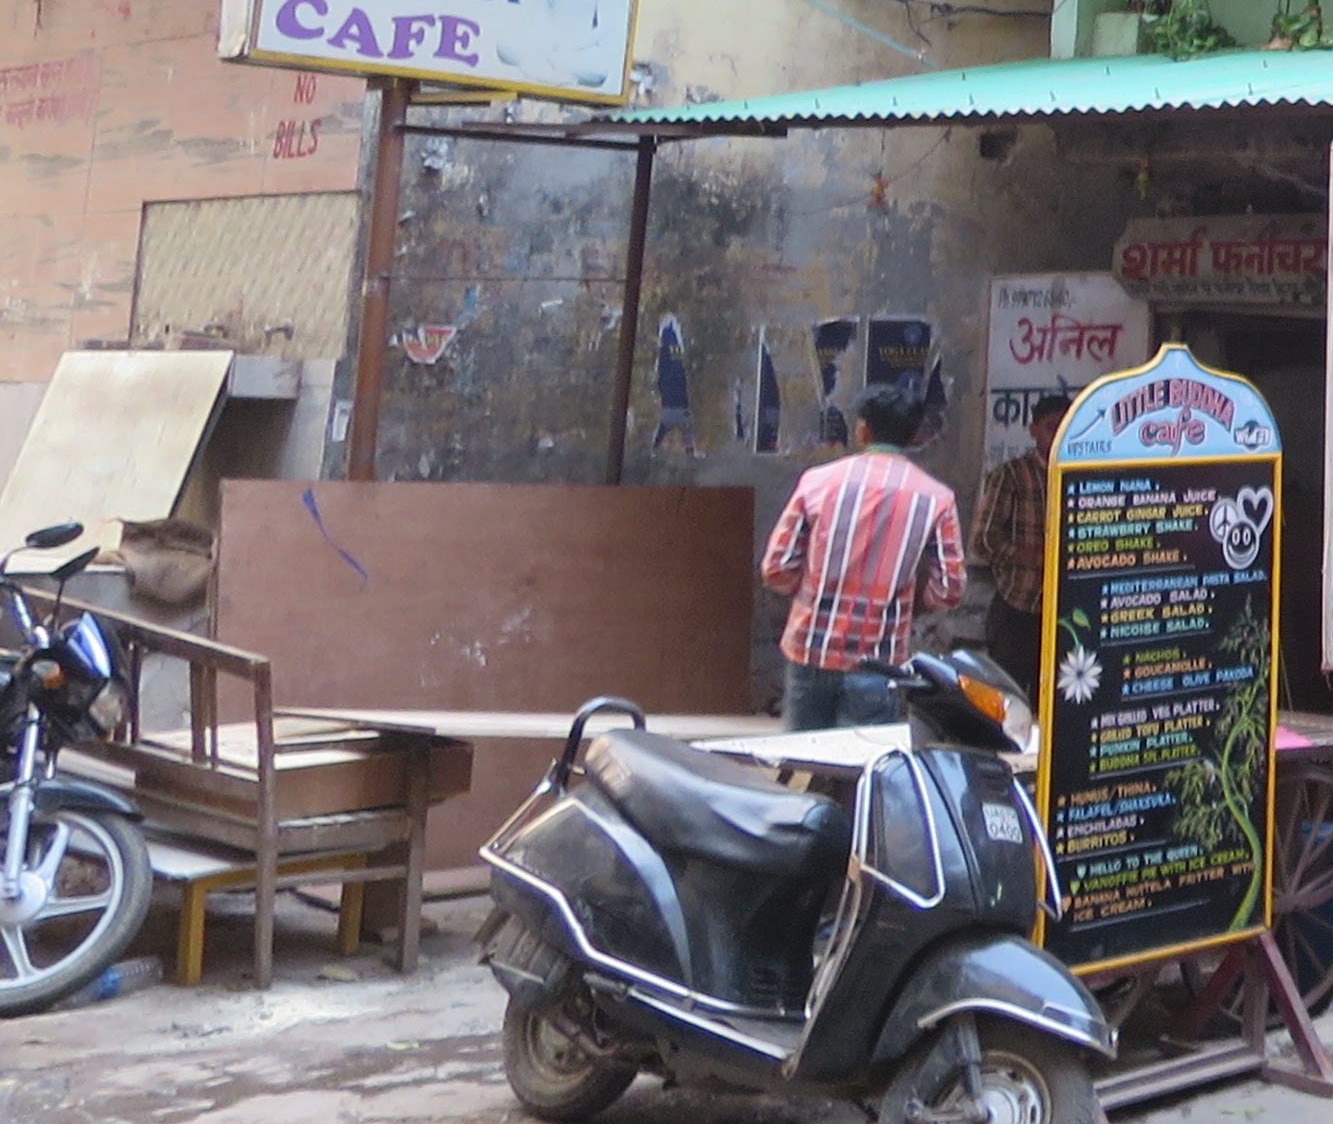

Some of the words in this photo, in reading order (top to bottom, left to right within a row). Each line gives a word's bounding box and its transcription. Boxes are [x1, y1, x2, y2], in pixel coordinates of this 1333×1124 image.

[294, 75, 317, 104] NO
[272, 119, 322, 160] BILLS
[1008, 313, 1124, 366] अनिल
[1111, 379, 1167, 437] LITTLE
[1168, 377, 1235, 434] BUDDHA
[1139, 407, 1206, 457] cafe
[1066, 439, 1113, 457] UPSTAIRS
[1079, 479, 1116, 495] LEMON
[1078, 494, 1127, 509] ORANGE
[1132, 491, 1177, 507] BANANA
[1076, 509, 1122, 524] CARROT
[1076, 554, 1137, 571] AVOCADO
[1110, 592, 1162, 610] AVOCADO
[1110, 607, 1156, 625] GREEK
[1089, 859, 1122, 876] HELLO
[1126, 855, 1140, 870] TO
[1143, 851, 1163, 867] THE
[1159, 861, 1187, 877] WITH
[1188, 856, 1207, 871] ICE
